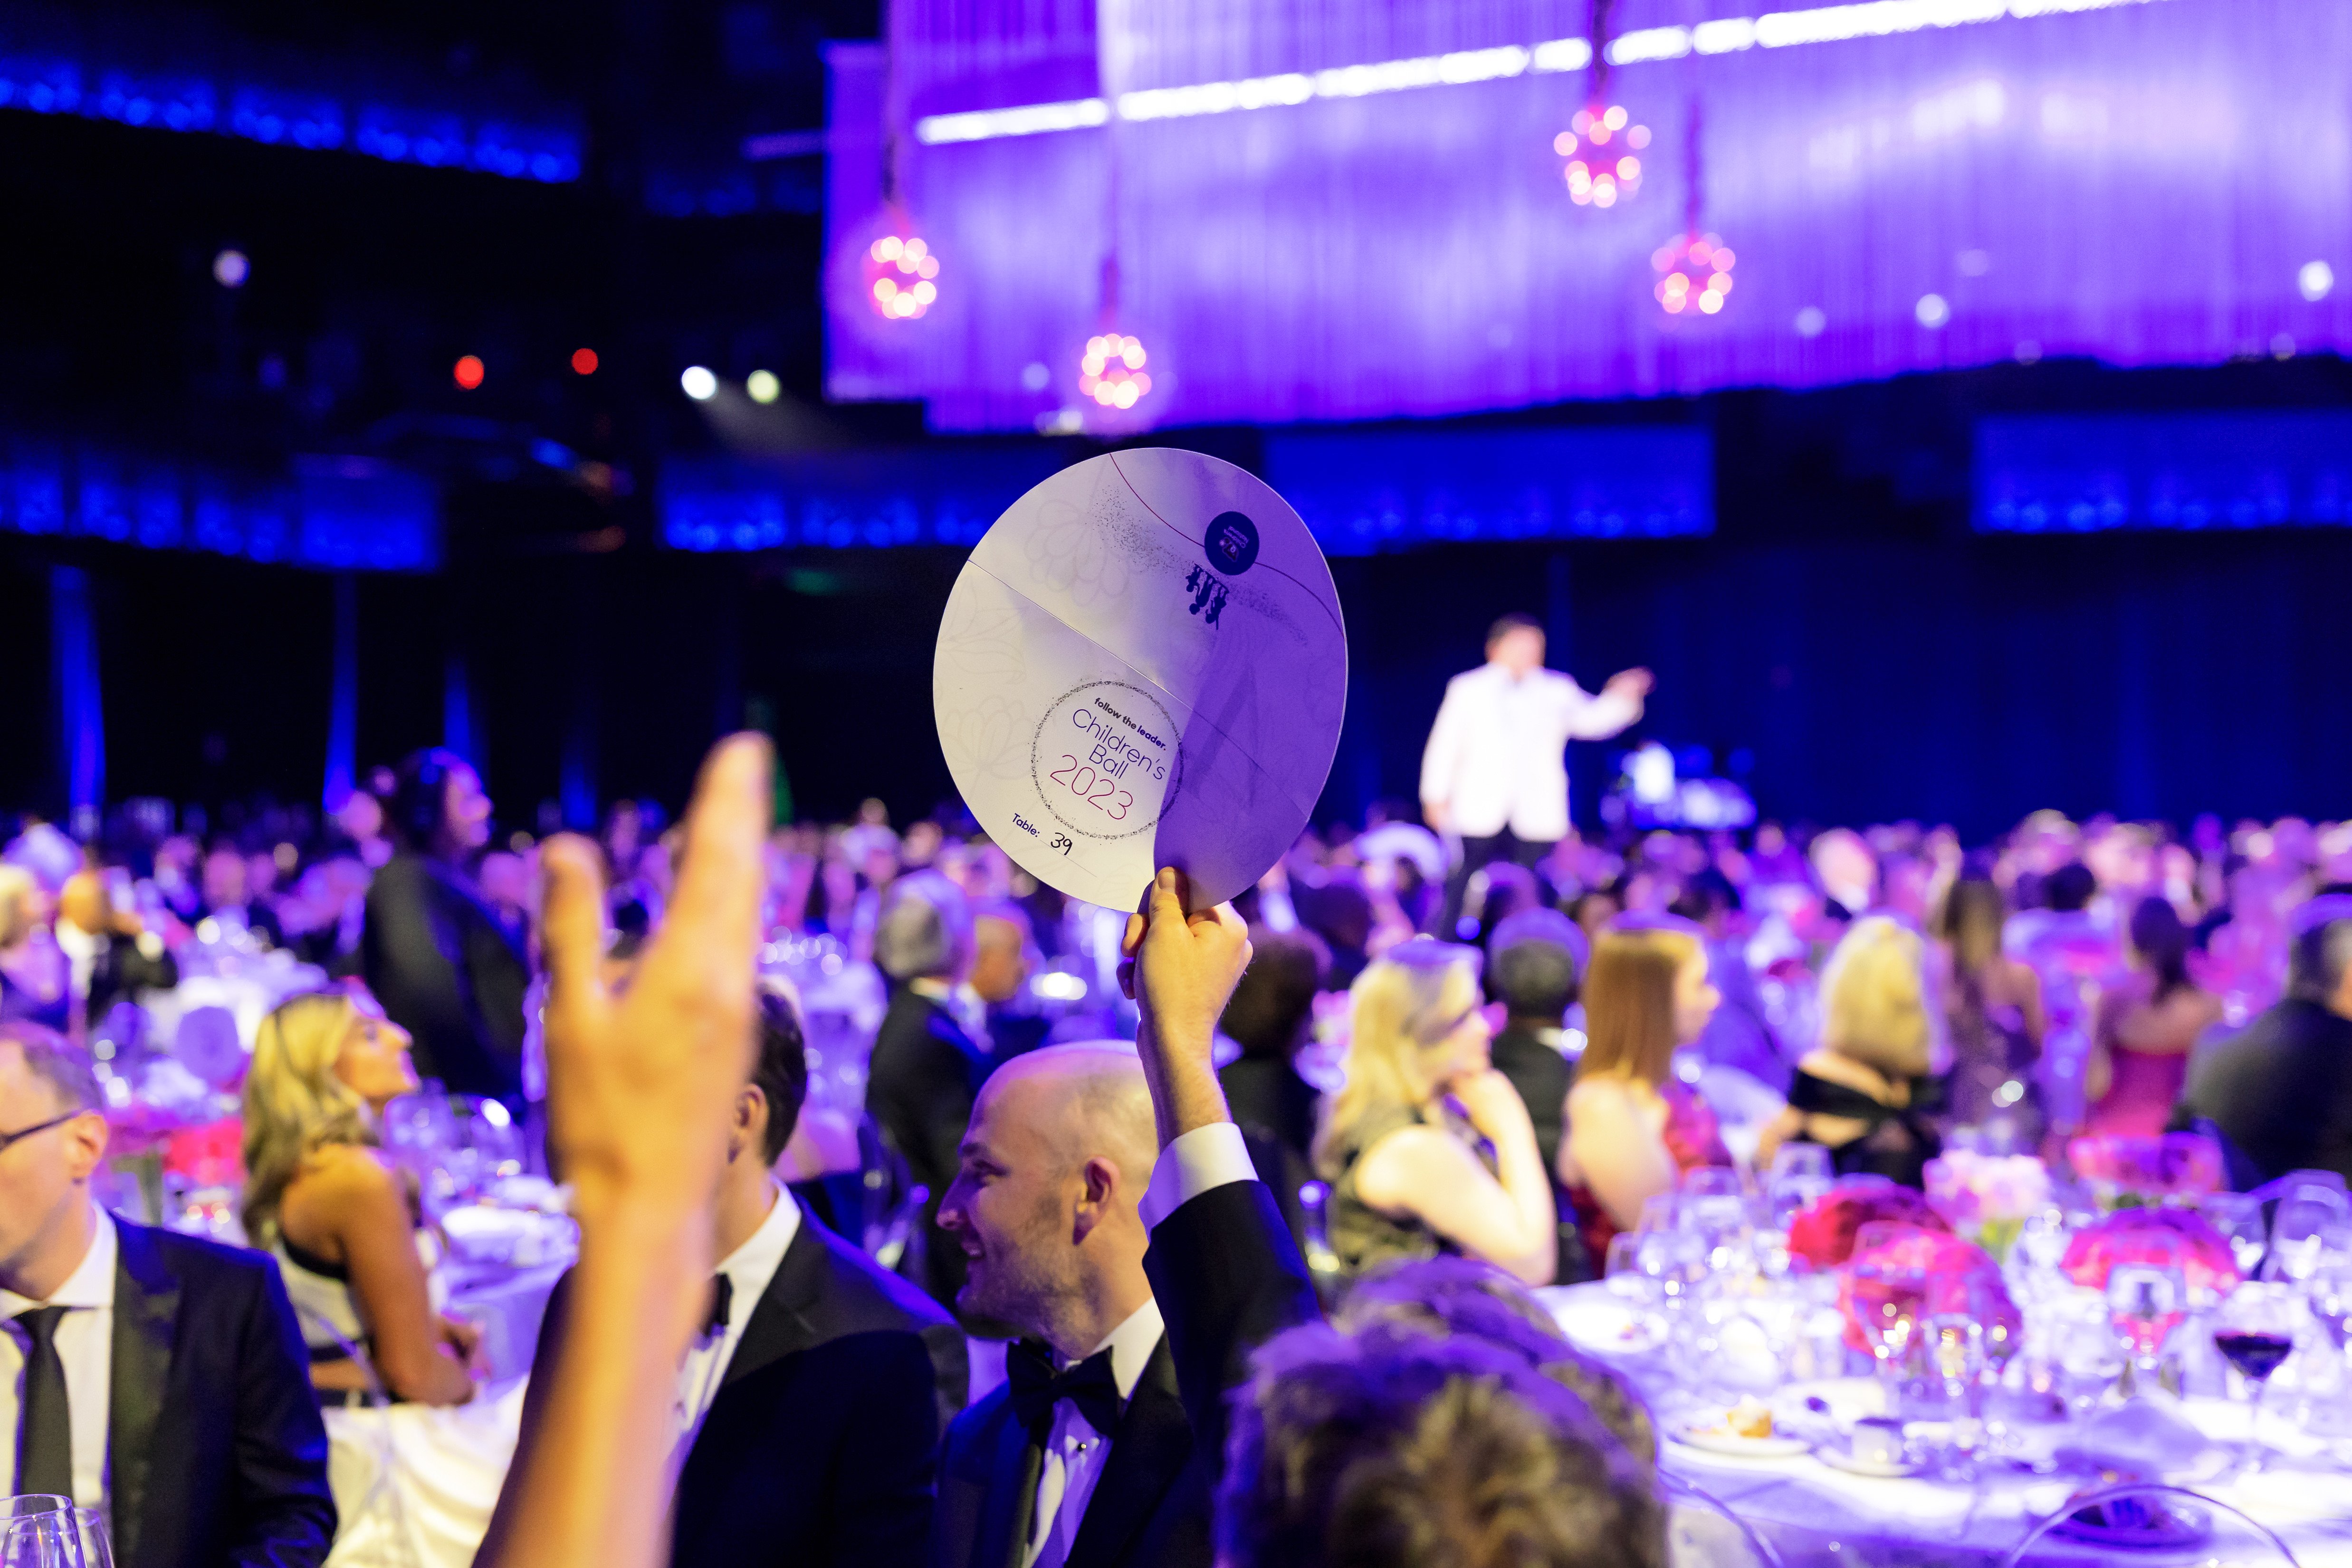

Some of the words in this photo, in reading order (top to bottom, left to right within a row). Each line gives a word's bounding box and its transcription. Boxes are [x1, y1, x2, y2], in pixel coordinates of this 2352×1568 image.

[1073, 708, 1166, 780] Children's
[1094, 698, 1121, 719] follow
[1122, 716, 1137, 729] the
[1137, 725, 1166, 751] leader.
[1089, 743, 1129, 779] Ball
[1050, 755, 1133, 820] 2023
[1012, 813, 1040, 837] Table:
[1050, 832, 1073, 856] 39
